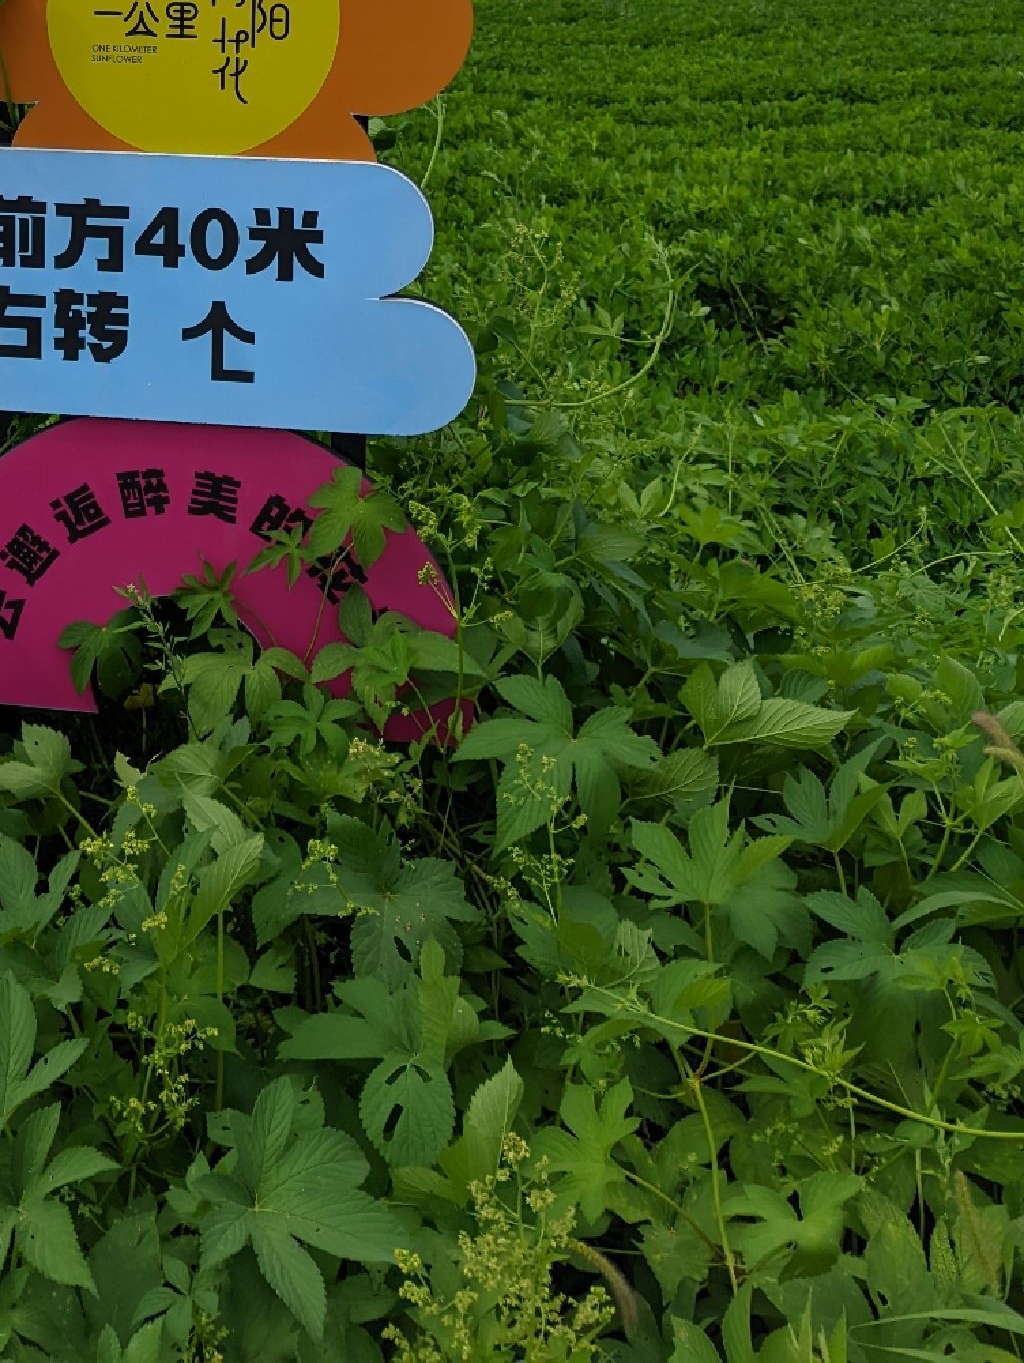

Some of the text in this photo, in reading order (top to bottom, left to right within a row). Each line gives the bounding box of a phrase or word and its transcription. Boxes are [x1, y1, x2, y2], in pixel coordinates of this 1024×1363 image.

[93, 1, 199, 39] 一公里
[92, 44, 158, 54] ONE KILOMETER
[91, 55, 143, 64] SUNFLOWER
